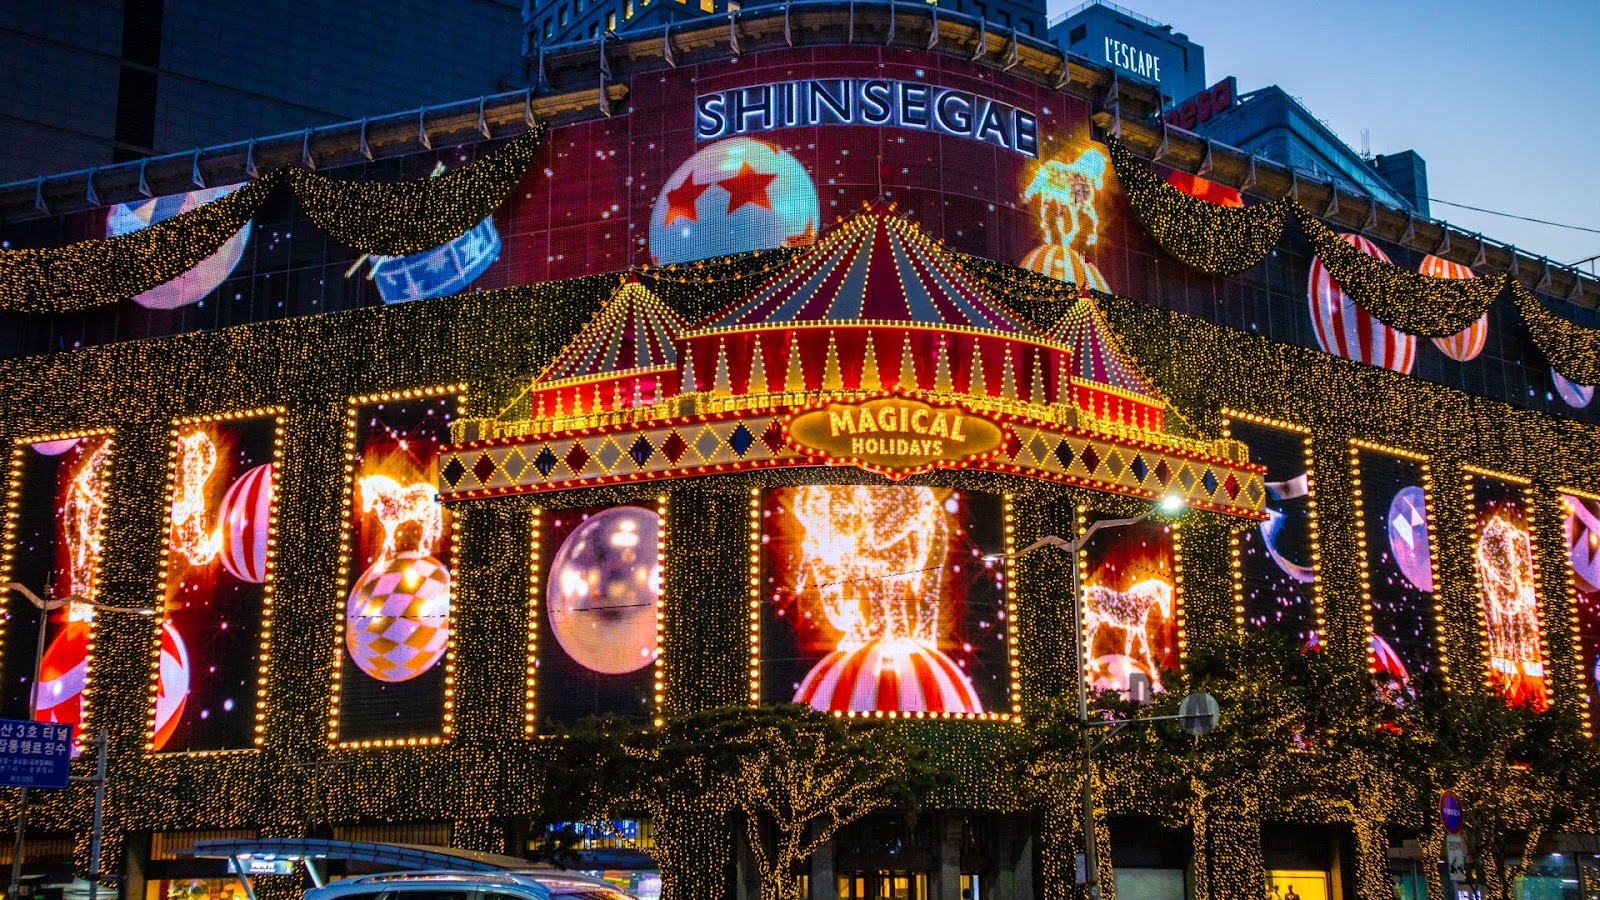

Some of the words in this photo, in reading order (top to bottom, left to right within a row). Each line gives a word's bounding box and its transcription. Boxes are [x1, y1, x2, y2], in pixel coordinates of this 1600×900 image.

[1104, 36, 1161, 82] L'ESCAPE
[696, 77, 1038, 157] SHINSEGAE
[828, 406, 966, 442] MAGICAL
[851, 437, 944, 457] HOLIDAYS
